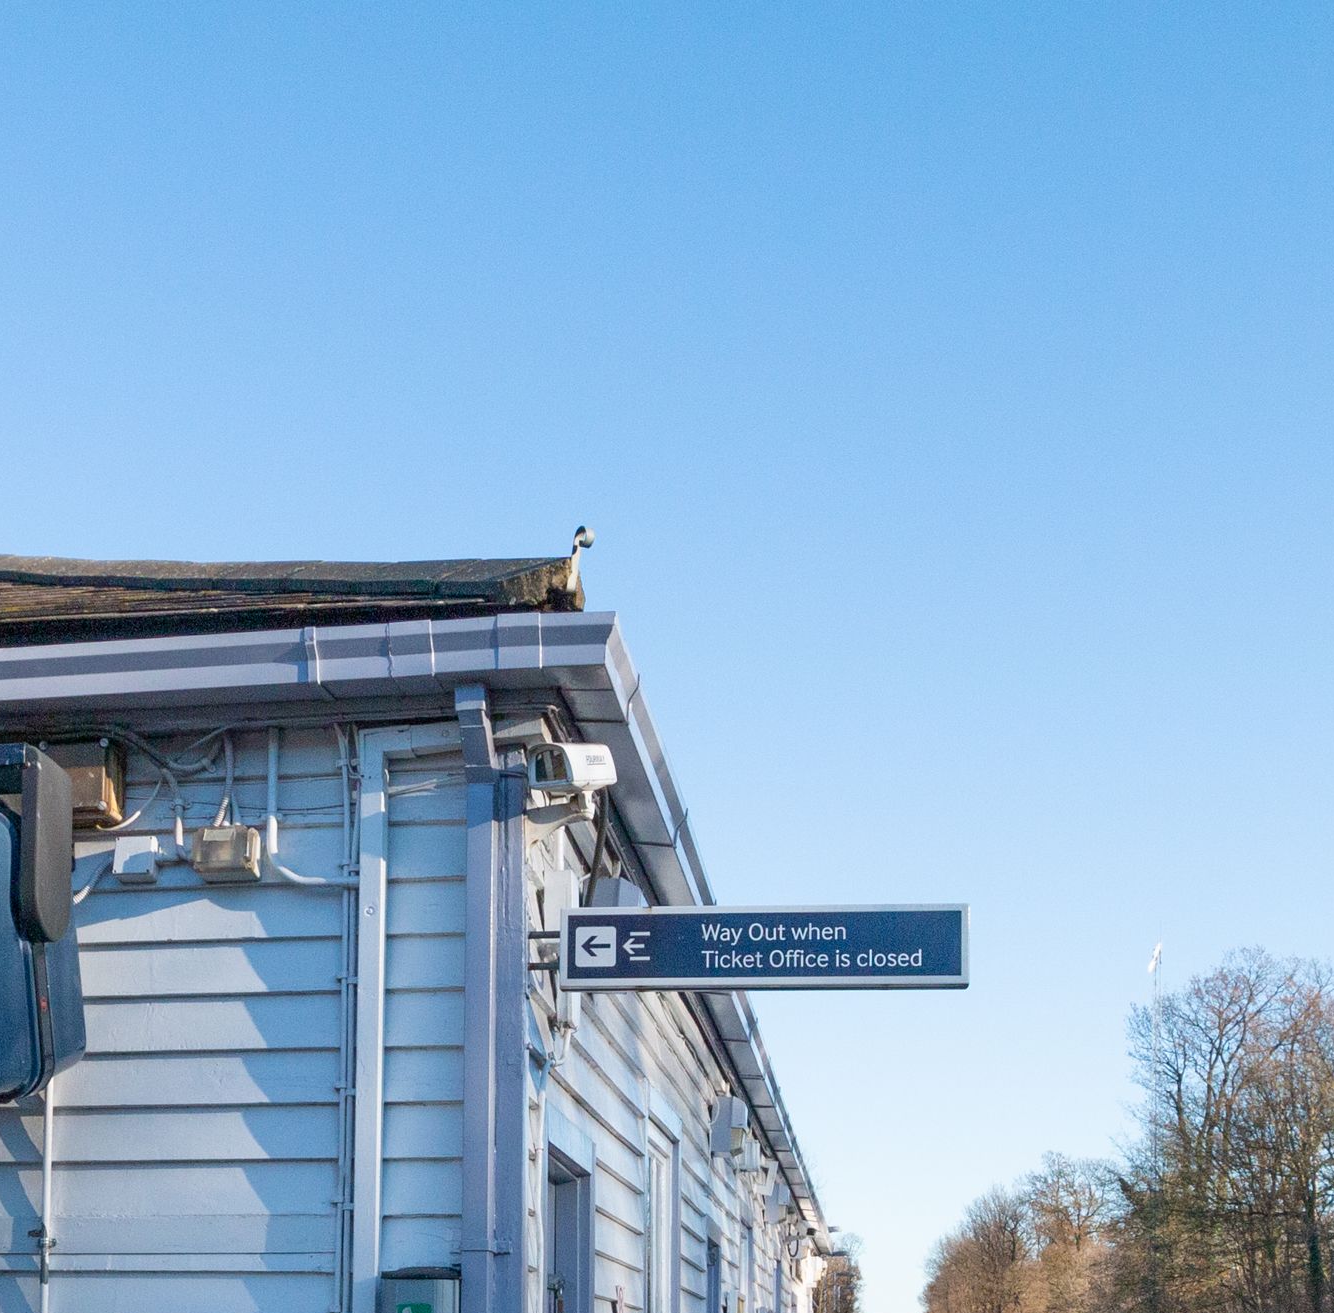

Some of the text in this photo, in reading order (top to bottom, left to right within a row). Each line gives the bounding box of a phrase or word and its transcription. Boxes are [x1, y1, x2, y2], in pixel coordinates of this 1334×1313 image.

[701, 922, 847, 946] Way Out when
[701, 948, 923, 969] Ticket Office is closed
